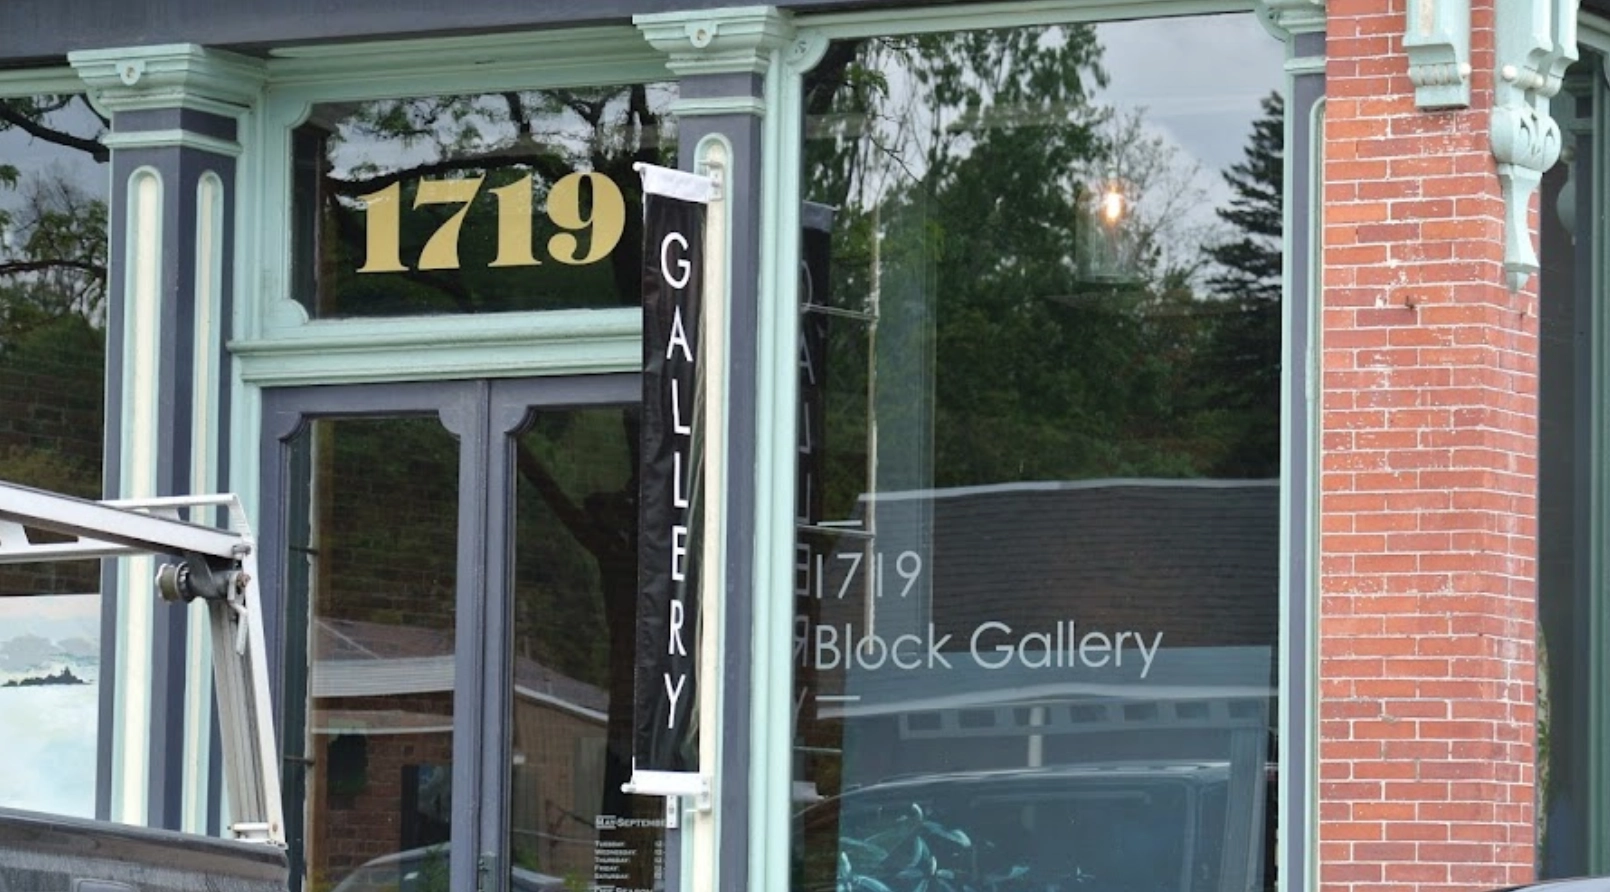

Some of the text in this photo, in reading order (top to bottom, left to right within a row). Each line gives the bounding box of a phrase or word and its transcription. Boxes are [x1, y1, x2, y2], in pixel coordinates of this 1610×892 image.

[356, 171, 626, 273] 1719
[661, 231, 694, 729] GALLERY
[816, 551, 922, 599] 1719
[815, 620, 1164, 679] Block Gallery
